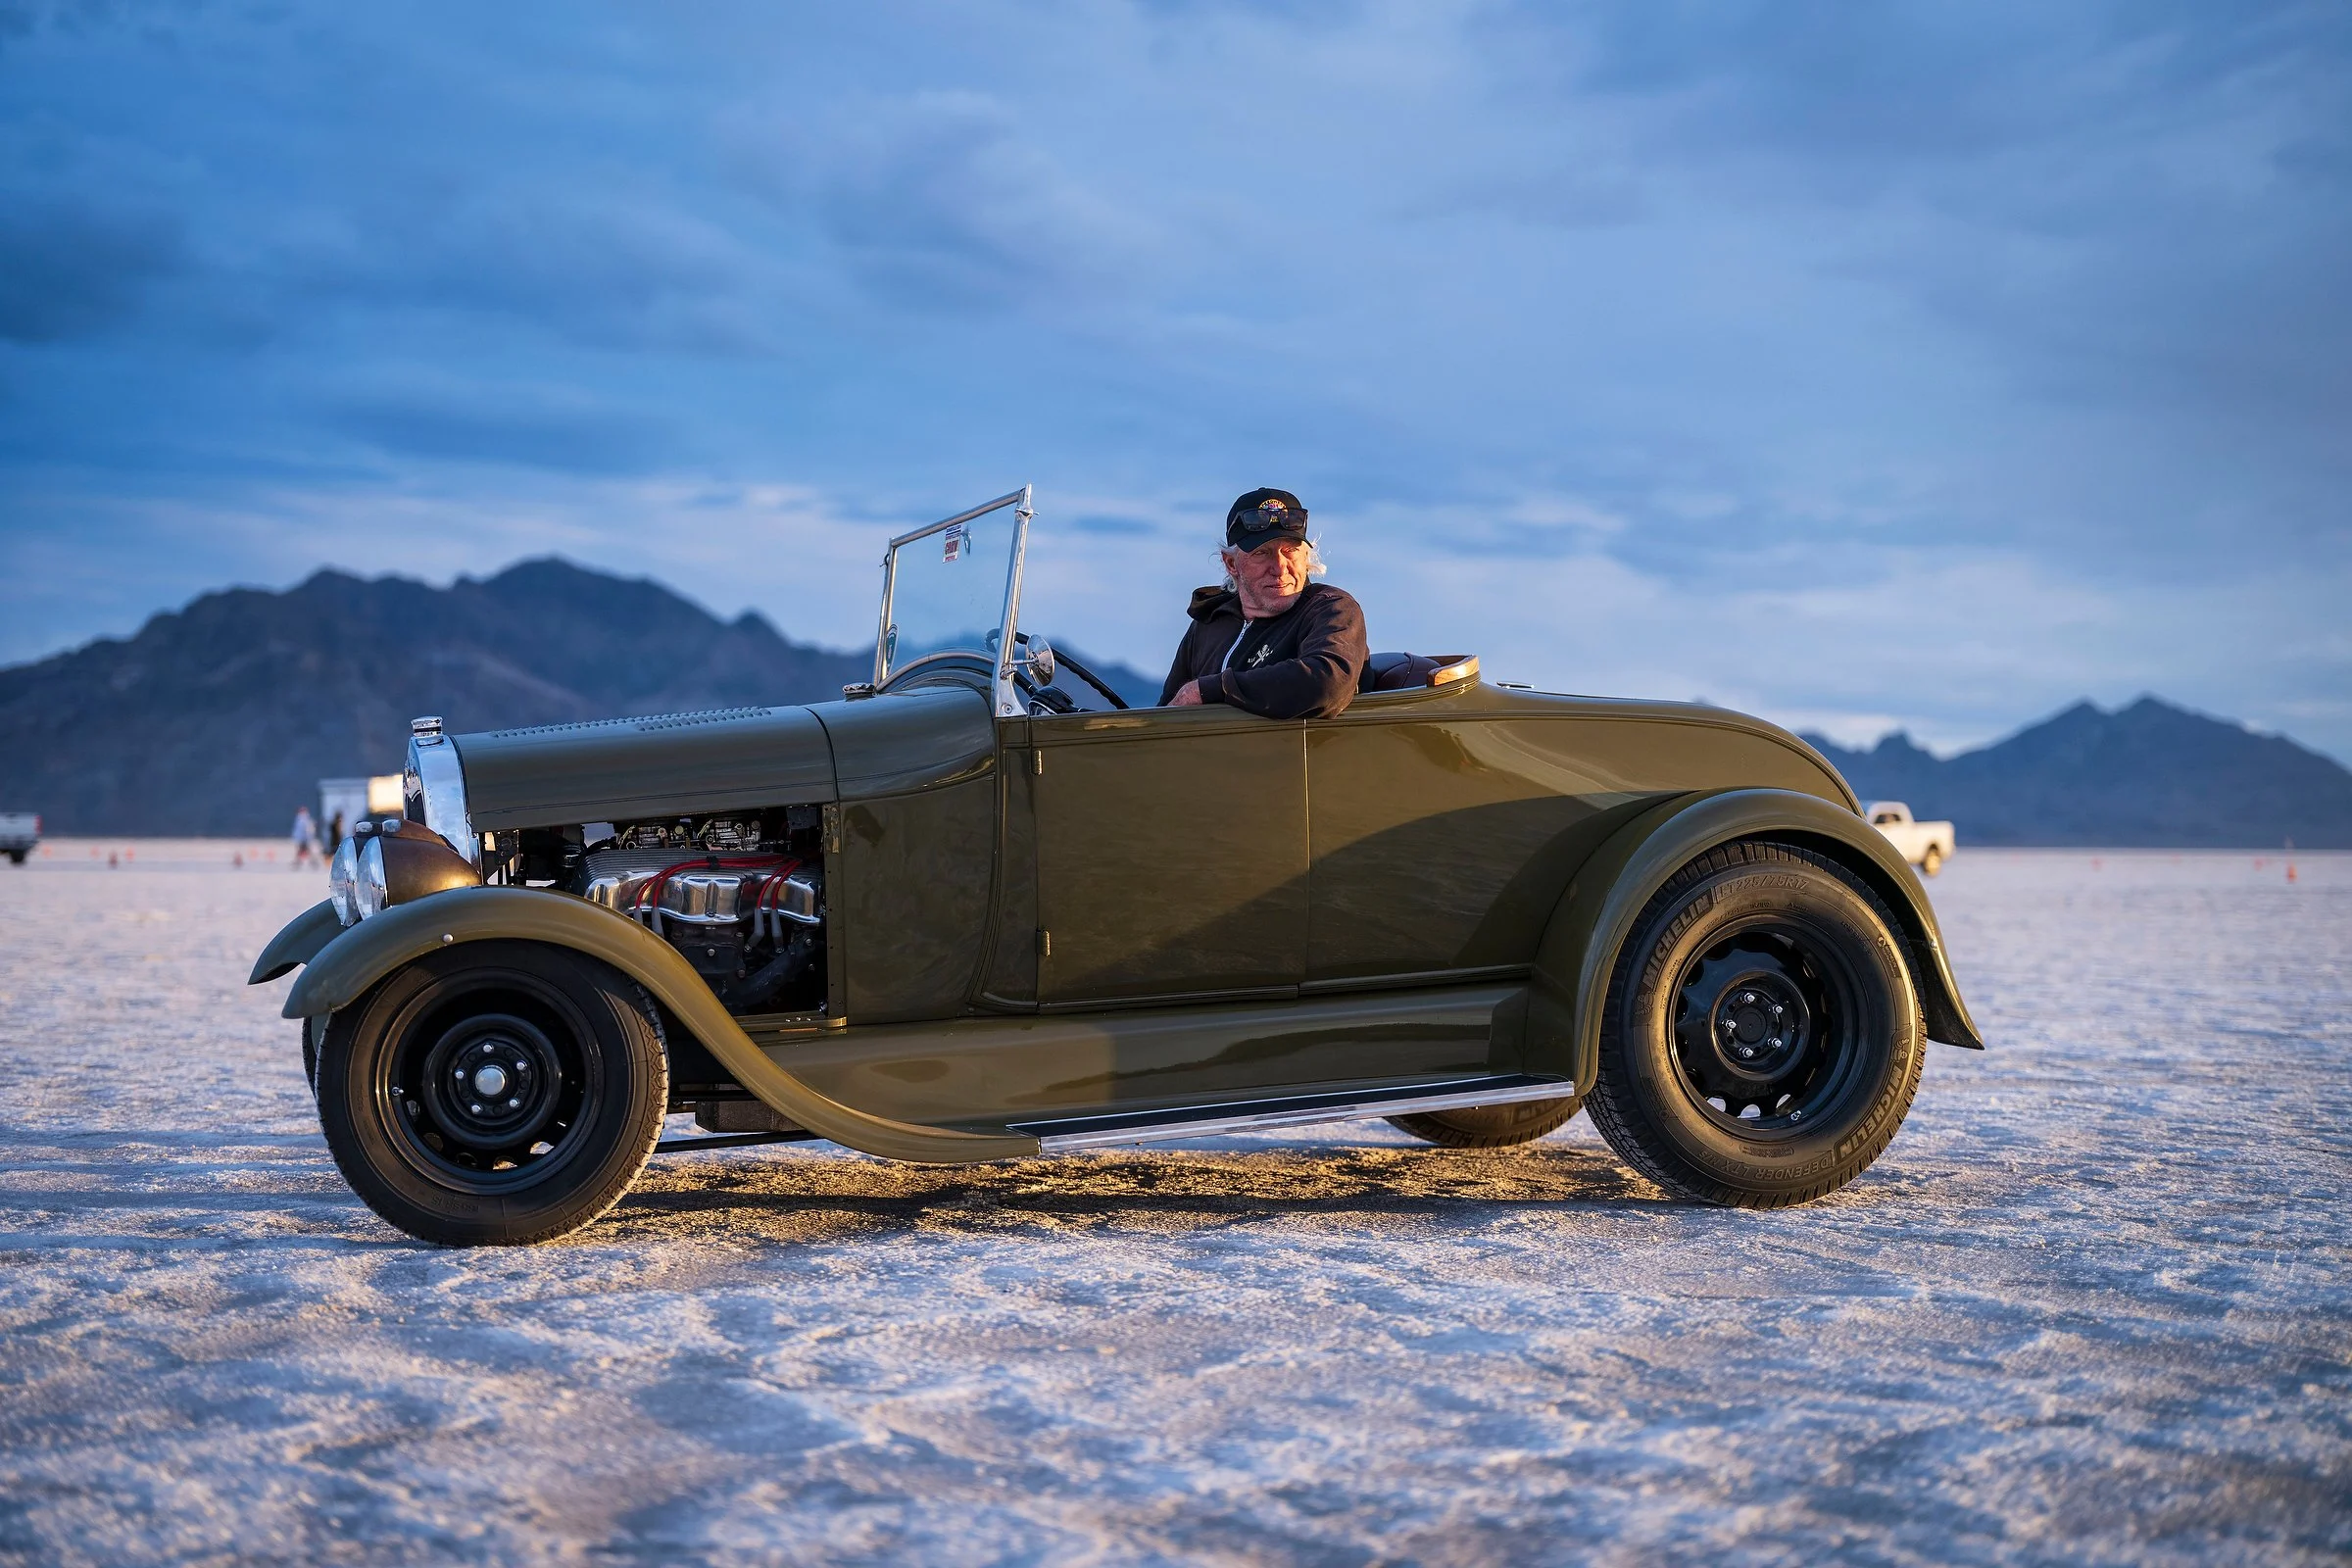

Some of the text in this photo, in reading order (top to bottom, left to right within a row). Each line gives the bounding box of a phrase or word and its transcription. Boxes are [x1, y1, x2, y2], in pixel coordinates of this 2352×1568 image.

[1642, 895, 1710, 989] MICHELIN
[1839, 1065, 1903, 1158] MICHELIN
[1725, 1159, 1749, 1176] LTX
[1754, 1156, 1829, 1180] DEFENDER
